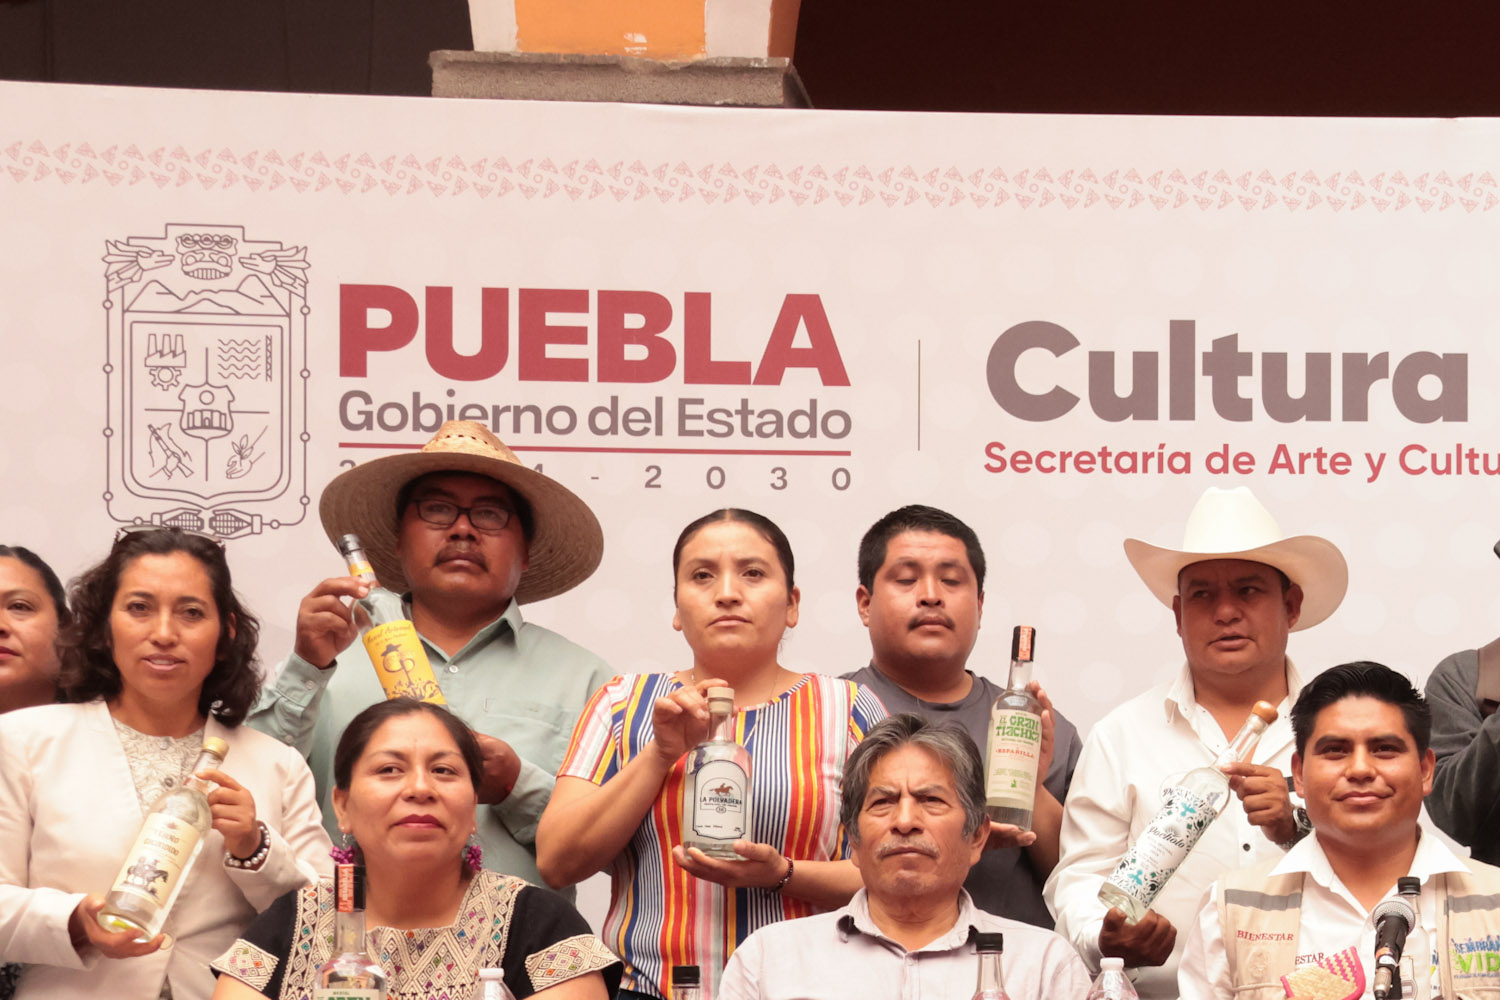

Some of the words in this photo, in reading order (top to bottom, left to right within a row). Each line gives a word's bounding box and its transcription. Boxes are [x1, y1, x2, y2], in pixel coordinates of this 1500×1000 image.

[340, 284, 851, 386] PUEBLA
[987, 320, 1467, 423] Cultura
[339, 390, 577, 435] Gobierno
[588, 396, 662, 436] del
[678, 398, 851, 439] Estado
[984, 442, 1190, 474] Secretaría
[1206, 444, 1255, 474] de
[1268, 444, 1352, 475] Arte
[1365, 453, 1386, 483] y
[1237, 930, 1294, 941] BIENESTAR
